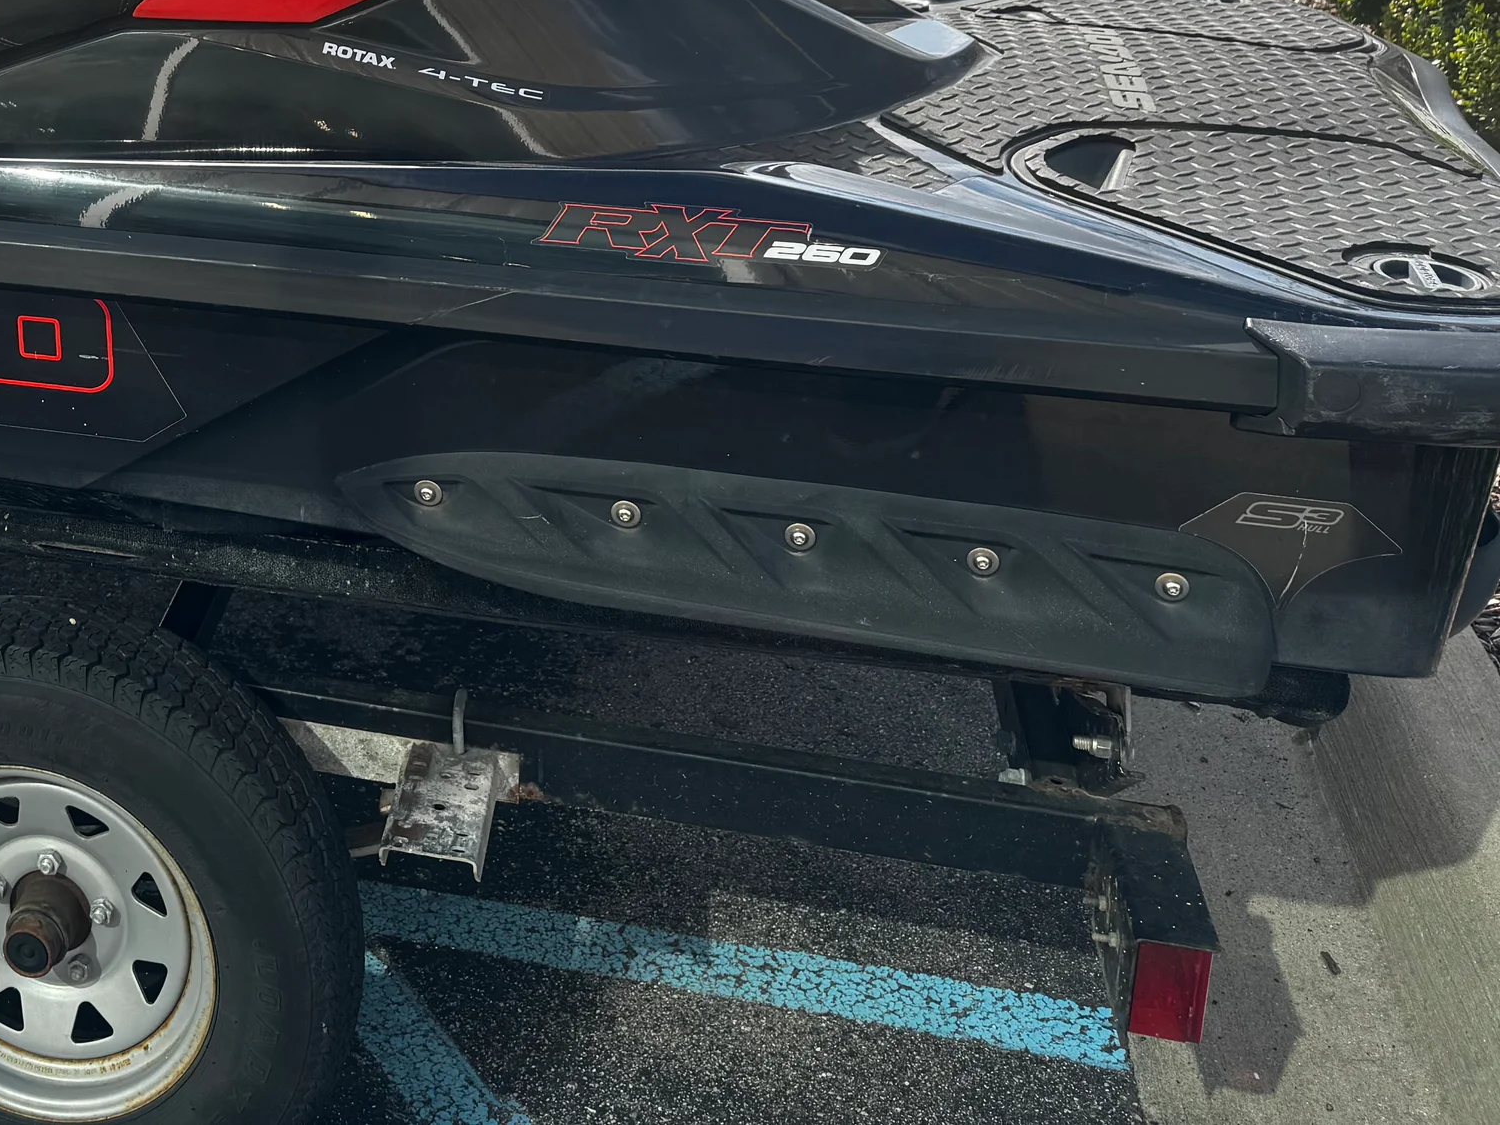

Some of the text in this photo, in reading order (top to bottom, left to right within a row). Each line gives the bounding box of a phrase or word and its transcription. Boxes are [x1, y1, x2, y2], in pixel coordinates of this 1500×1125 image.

[322, 42, 544, 100] ROTAX 4-TEC
[539, 203, 881, 266] RXT 260
[1235, 502, 1345, 529] S3
[1297, 524, 1330, 534] HULL
